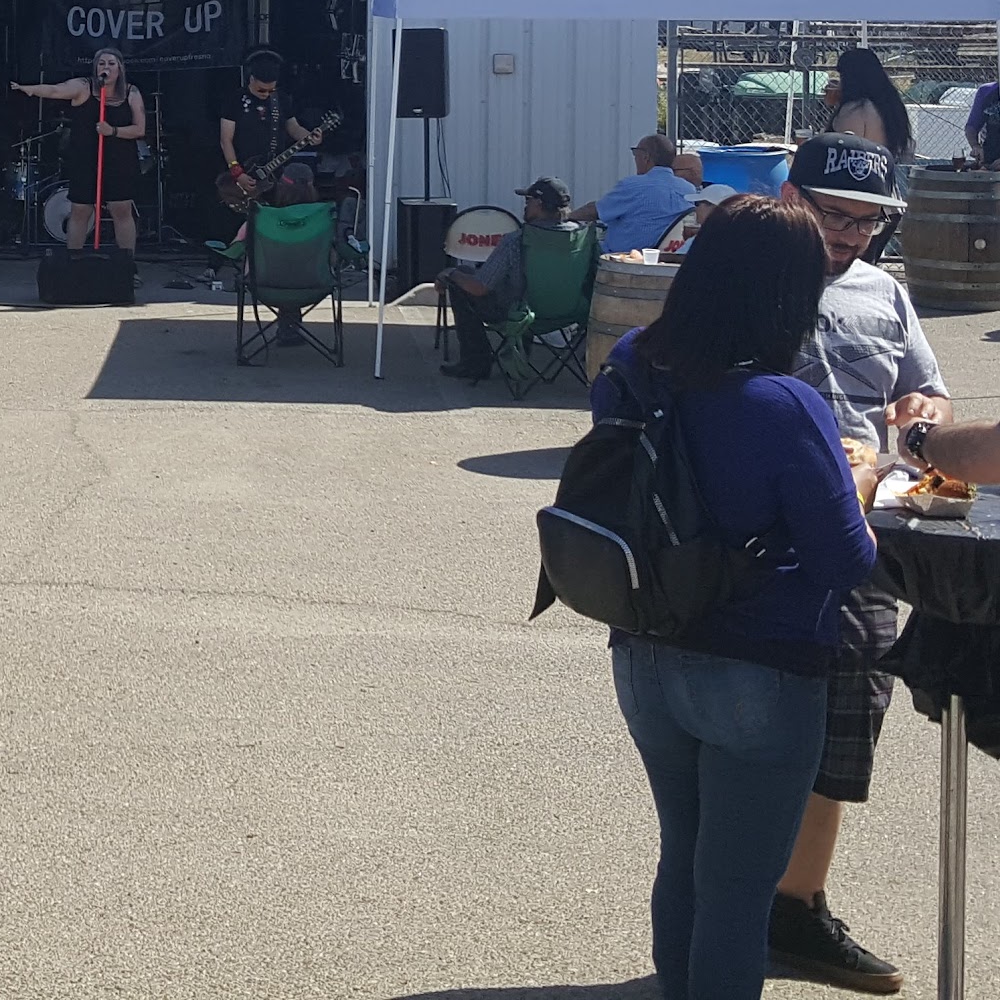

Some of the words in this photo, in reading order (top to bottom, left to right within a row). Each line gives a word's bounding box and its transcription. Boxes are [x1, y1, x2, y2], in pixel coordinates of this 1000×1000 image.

[66, 5, 165, 40] COVER
[184, 0, 222, 33] UP
[458, 233, 505, 247] JONE
